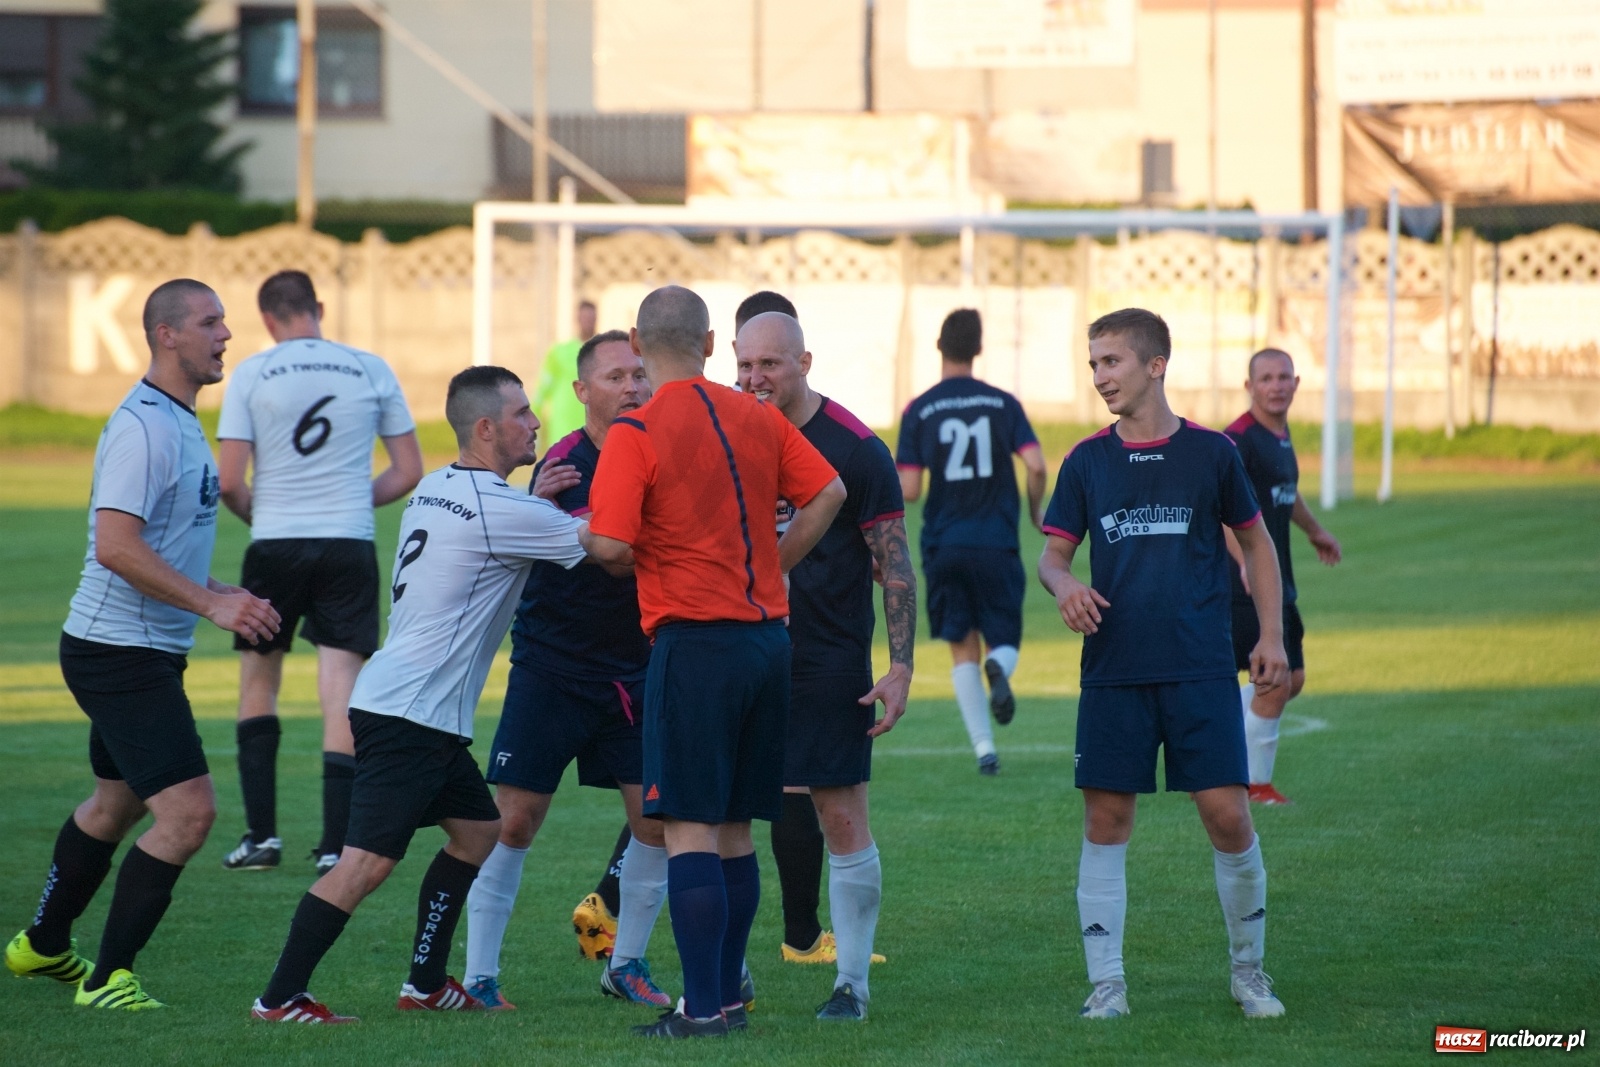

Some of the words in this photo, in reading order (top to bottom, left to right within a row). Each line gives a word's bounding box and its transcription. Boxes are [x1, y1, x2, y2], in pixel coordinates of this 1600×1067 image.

[261, 366, 288, 380] LKS
[292, 395, 337, 456] 6
[939, 415, 993, 482] 21
[417, 495, 478, 521] TWORKÓW
[1129, 503, 1193, 524] KÜHN
[392, 528, 429, 603] 2
